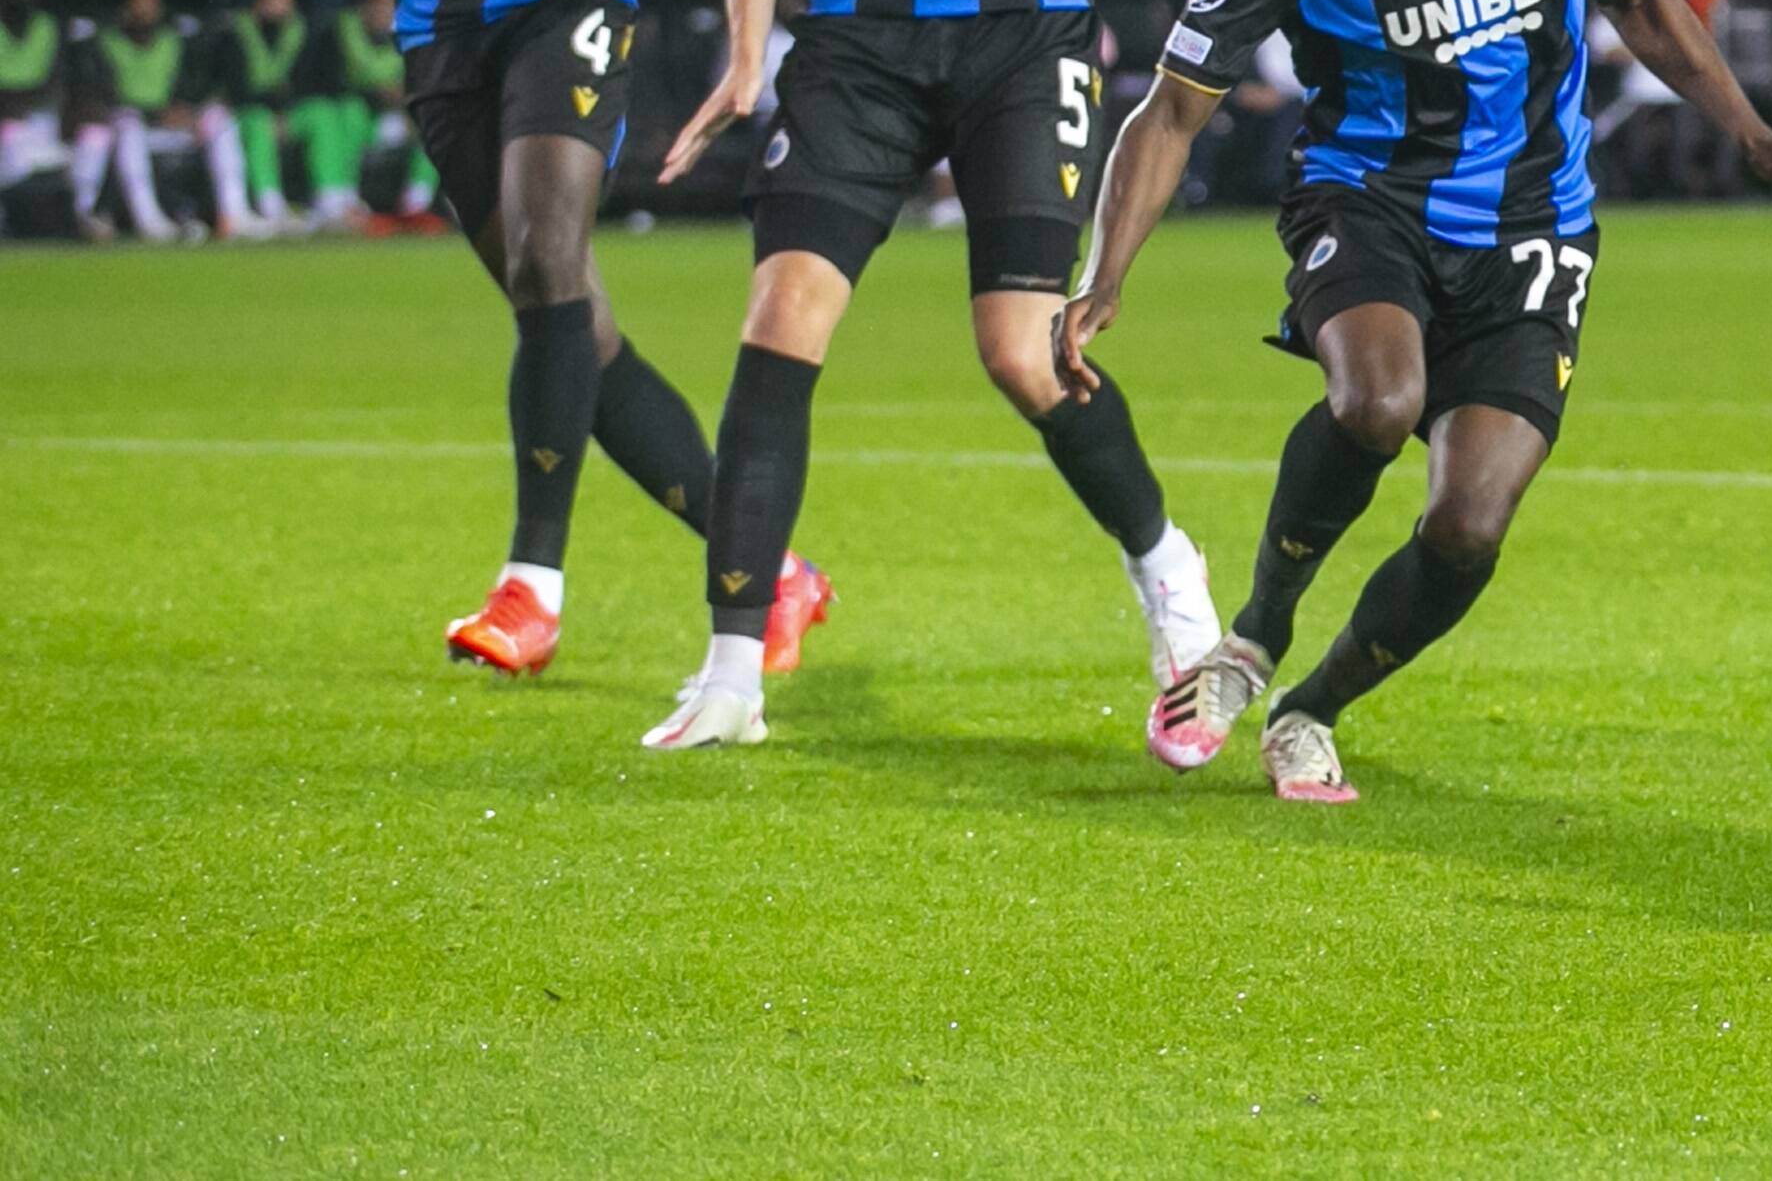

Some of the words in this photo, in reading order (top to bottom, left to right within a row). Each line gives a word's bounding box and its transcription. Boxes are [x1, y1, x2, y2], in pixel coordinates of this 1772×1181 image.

[570, 7, 612, 76] 4
[1056, 57, 1090, 149] 5
[1511, 238, 1593, 329] 77
